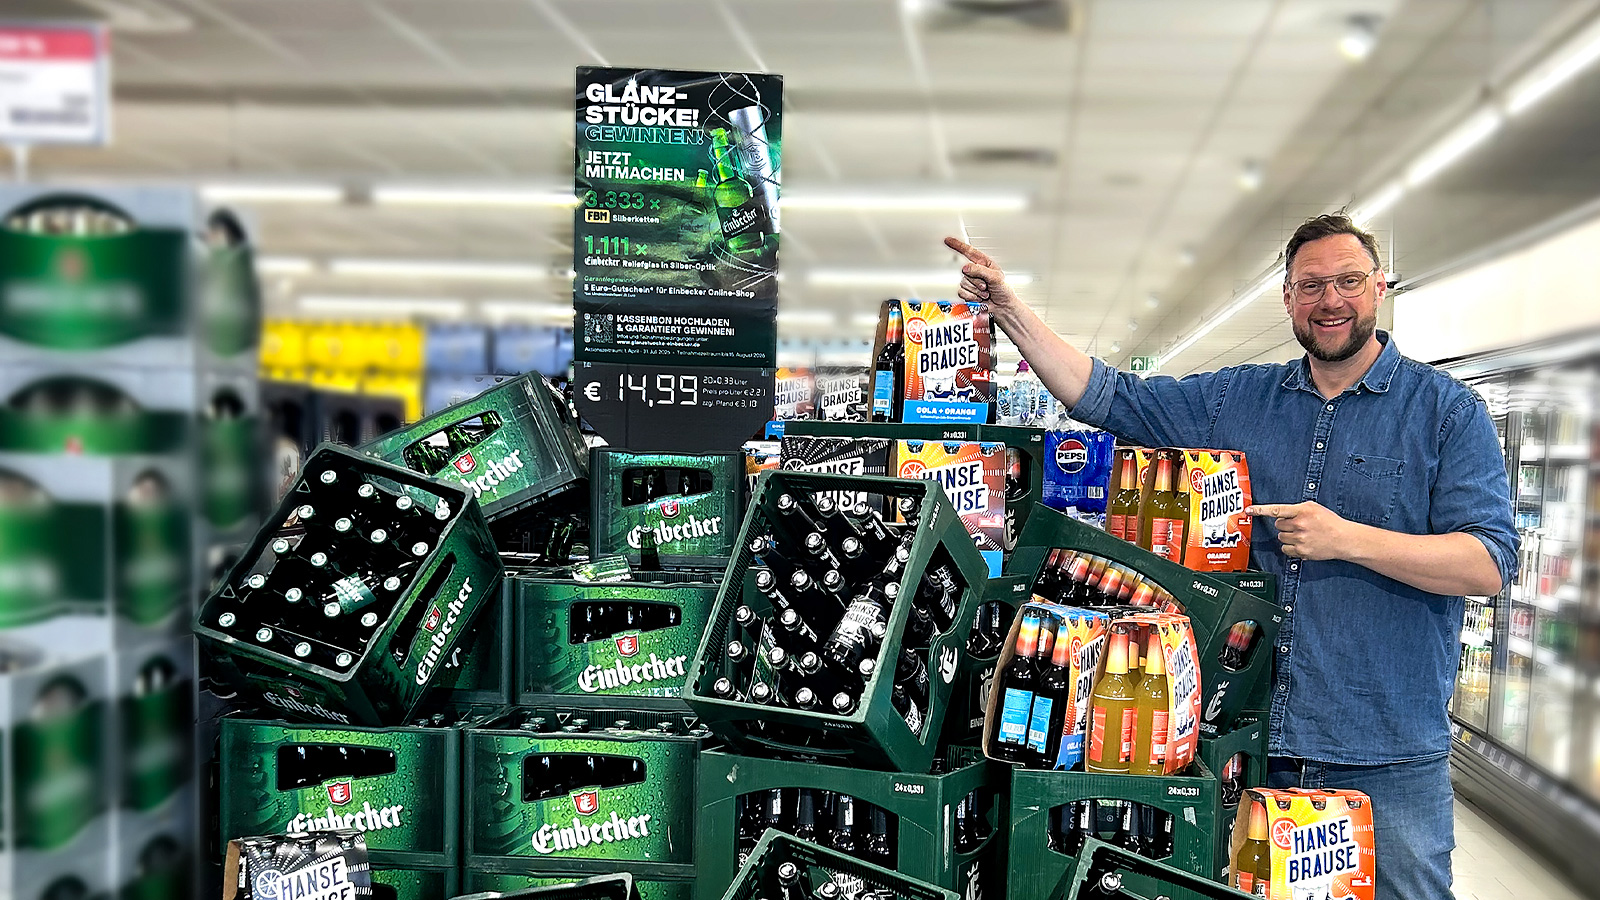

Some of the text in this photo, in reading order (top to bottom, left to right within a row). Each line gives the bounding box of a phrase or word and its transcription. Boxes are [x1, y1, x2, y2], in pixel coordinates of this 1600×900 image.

[585, 102, 699, 127] STÜCKE!
[585, 125, 704, 145] GEWINNEN!
[585, 151, 632, 165] JETZT
[585, 165, 684, 181] MITMACHEN
[585, 190, 645, 209] 3.333
[588, 211, 660, 224] FBM Silberketten
[722, 208, 758, 233] Einbecker
[584, 235, 629, 255] 1.111
[584, 256, 620, 267] Einbecker
[622, 260, 660, 270] Reliefglas
[670, 261, 716, 272] Silber-Optik
[669, 287, 706, 295] Einbecker
[708, 288, 755, 298] Online-Shop
[617, 315, 730, 326] KASSENBON HOCHLADEN
[625, 324, 682, 334] GARANTIERT
[684, 327, 735, 336] GEWINNEN!
[925, 322, 971, 349] HANSE
[920, 344, 976, 373] BRAUSE
[584, 373, 698, 407] € 14,99
[777, 378, 807, 393] HANSE
[827, 378, 857, 393] HANSE
[775, 389, 810, 406] BRAUSE
[824, 389, 860, 407] BRAUSE
[1058, 452, 1086, 461] PEPSI
[1204, 469, 1238, 498] HANSE
[1201, 494, 1241, 522] BRAUSE
[414, 577, 473, 686] Einbecker
[577, 653, 687, 693] Einbecker
[264, 691, 349, 726] Einbecker
[287, 801, 403, 832] Einbecker
[532, 811, 651, 854] Einbecker
[1294, 819, 1350, 855] HANSE
[1289, 845, 1357, 883] BRAUSE
[281, 860, 342, 900] HANSE
